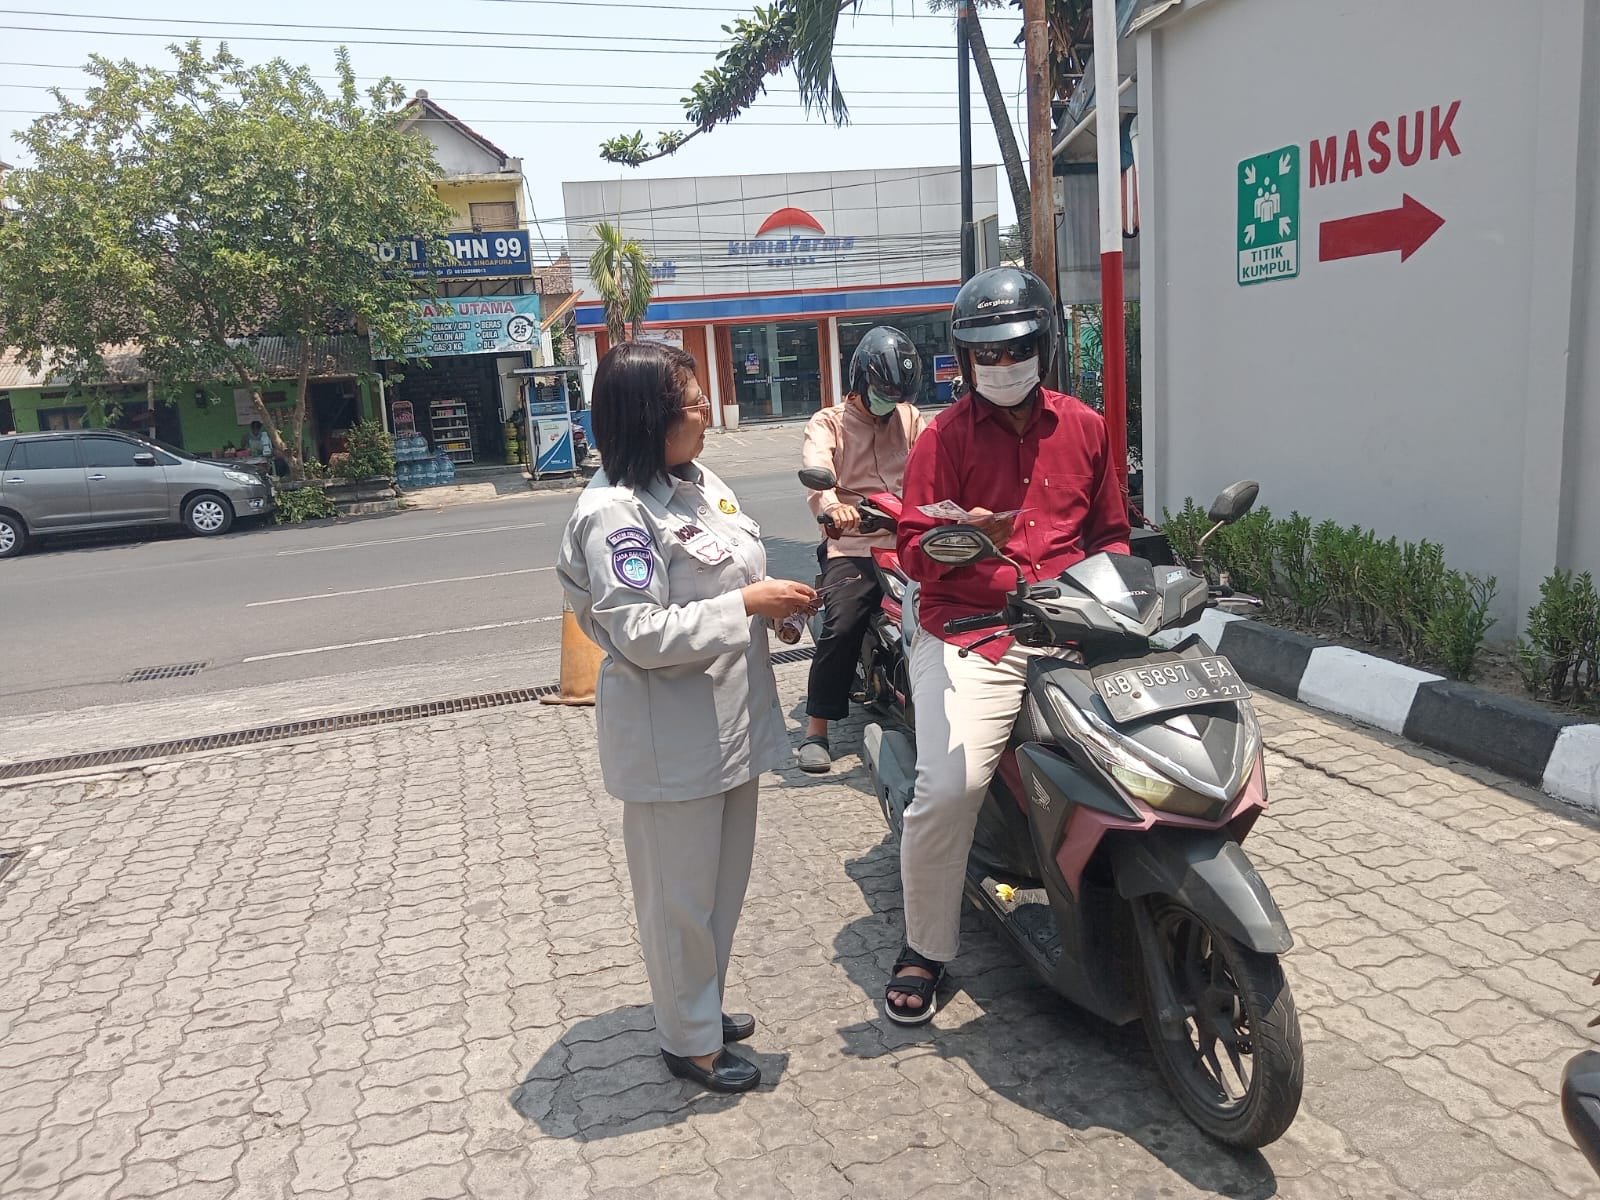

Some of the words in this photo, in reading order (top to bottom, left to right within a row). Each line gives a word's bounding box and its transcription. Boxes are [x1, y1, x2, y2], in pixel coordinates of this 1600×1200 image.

[1309, 100, 1462, 189] MASUK
[495, 238, 522, 258] 99
[1251, 246, 1284, 263] TITIK
[1242, 260, 1294, 279] KUMPUL
[458, 302, 515, 316] UTAMA
[480, 320, 501, 329] BERAS
[514, 325, 527, 334] 25
[432, 333, 453, 342] GALON
[454, 332, 465, 340] AIR
[482, 331, 498, 339] GULA
[433, 343, 448, 352] GAS
[453, 342, 463, 351] KG
[1103, 675, 1133, 698] AB
[1136, 664, 1191, 688] 5897
[1200, 659, 1233, 680] EA
